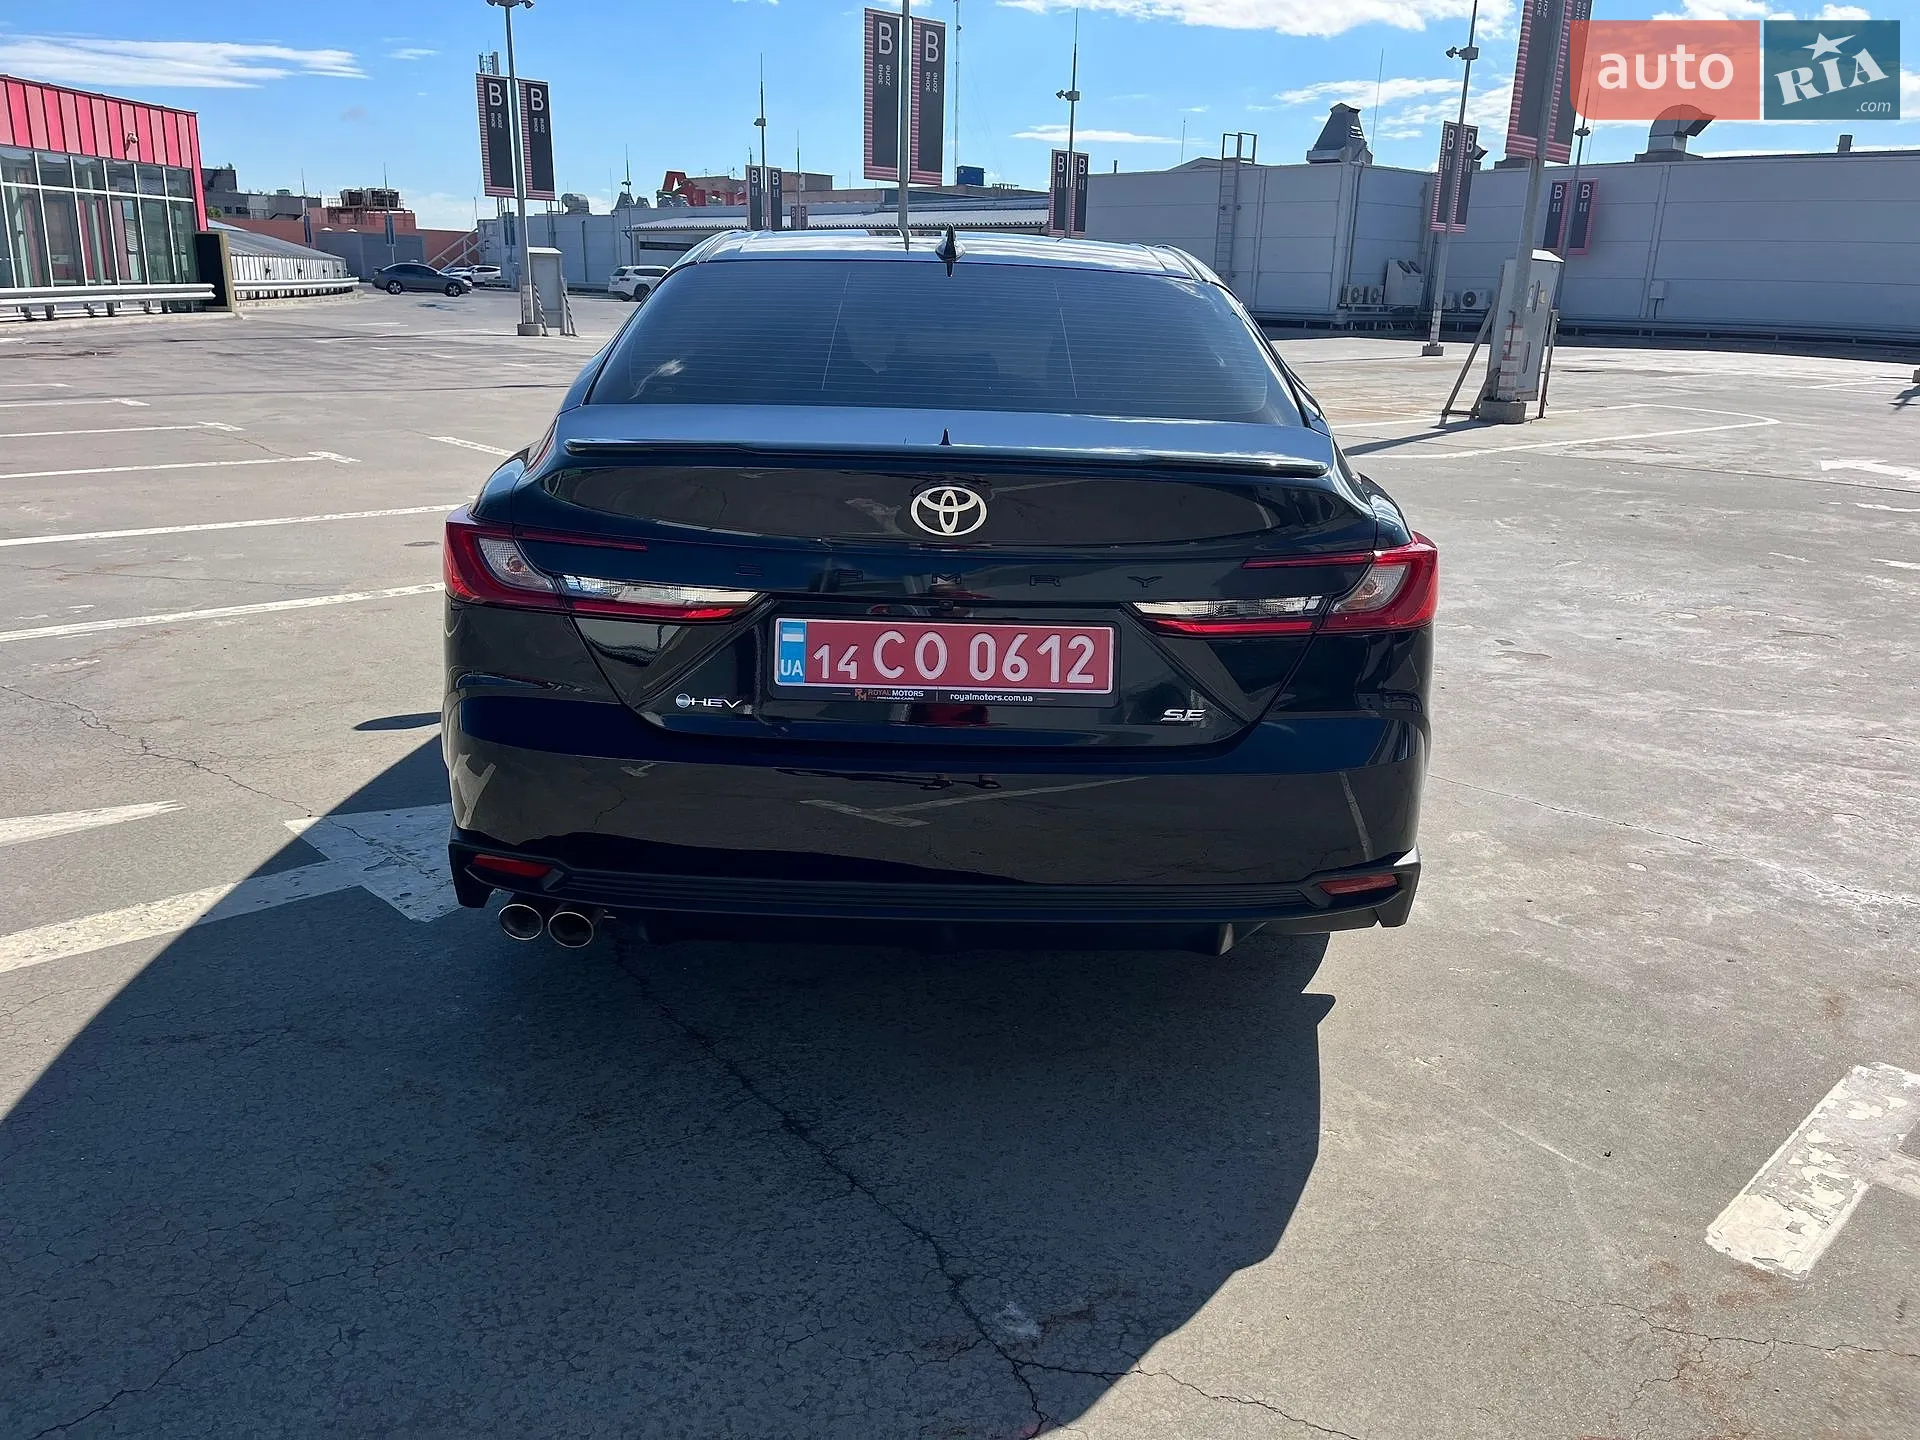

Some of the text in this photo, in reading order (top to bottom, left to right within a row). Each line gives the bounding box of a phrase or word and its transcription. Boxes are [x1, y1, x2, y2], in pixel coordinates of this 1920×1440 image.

[879, 21, 893, 55] B
[925, 30, 939, 62] B
[488, 82, 503, 106] B
[530, 87, 544, 111] B
[1447, 129, 1455, 150] B
[1466, 132, 1474, 153] B
[1057, 155, 1065, 173] B
[1078, 158, 1086, 175] B
[751, 169, 759, 184] B
[772, 171, 780, 185] B
[1554, 184, 1563, 199] B
[1581, 183, 1590, 199] B
[813, 630, 1096, 685] 14 CO 0612
[780, 658, 804, 677] UA
[891, 689, 924, 697] MOTORS
[950, 692, 1033, 702] royalmotors.com.ua
[1160, 708, 1207, 722] SE
